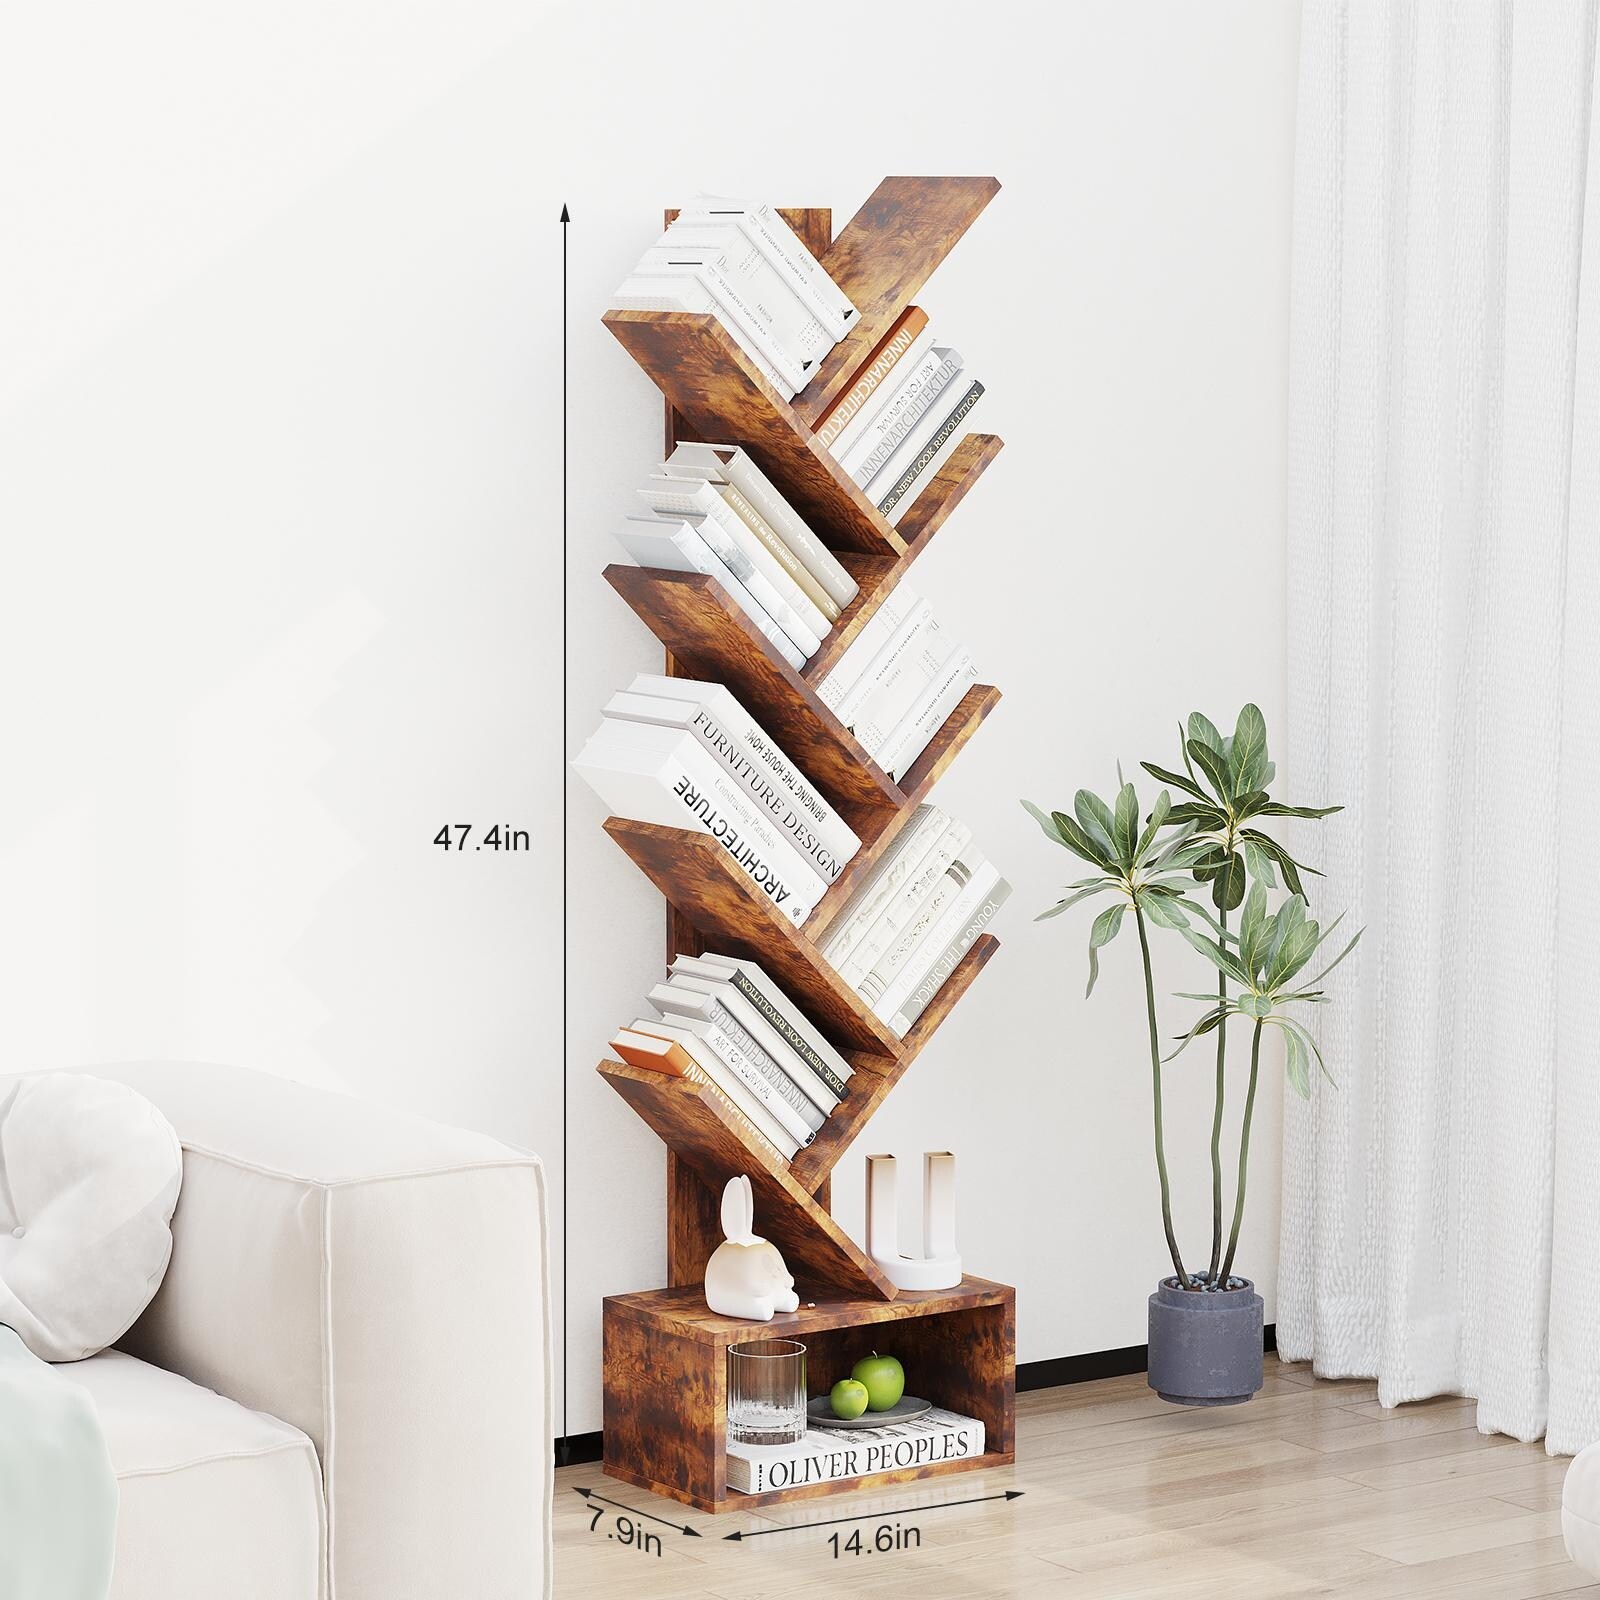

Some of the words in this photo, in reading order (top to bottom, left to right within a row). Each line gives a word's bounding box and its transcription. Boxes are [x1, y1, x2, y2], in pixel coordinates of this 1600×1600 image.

[907, 380, 923, 400] FOR
[918, 360, 934, 383] ART
[859, 358, 958, 481] INNENARCHITEKTUR
[876, 397, 908, 434] SURVIVAL
[896, 473, 914, 498] NEW
[912, 447, 936, 475] LOOK
[933, 389, 981, 451] REVOLUTION
[765, 533, 799, 572] Revolution
[743, 727, 765, 752] HOME
[761, 746, 787, 777] HOUSE
[782, 769, 798, 790] THE
[692, 710, 785, 816] FURNITURE
[782, 811, 842, 878] DESIGN
[796, 784, 828, 823] BRINGING
[673, 774, 791, 904] ARCHITECTURE
[965, 899, 1000, 940] YOUNG
[944, 949, 963, 973] THE
[738, 976, 789, 1036] REVOLUTION
[911, 967, 947, 1009] SHACK
[708, 1004, 809, 1113] INNENARCHITEKTUR
[713, 1033, 729, 1053] ART
[726, 1049, 746, 1074] FOR
[784, 1027, 808, 1055] LOOK
[804, 1050, 829, 1078] NEW
[826, 1069, 845, 1093] DIOR.
[768, 1449, 858, 1488] OLIVER
[866, 1431, 969, 1472] PEOPLES
